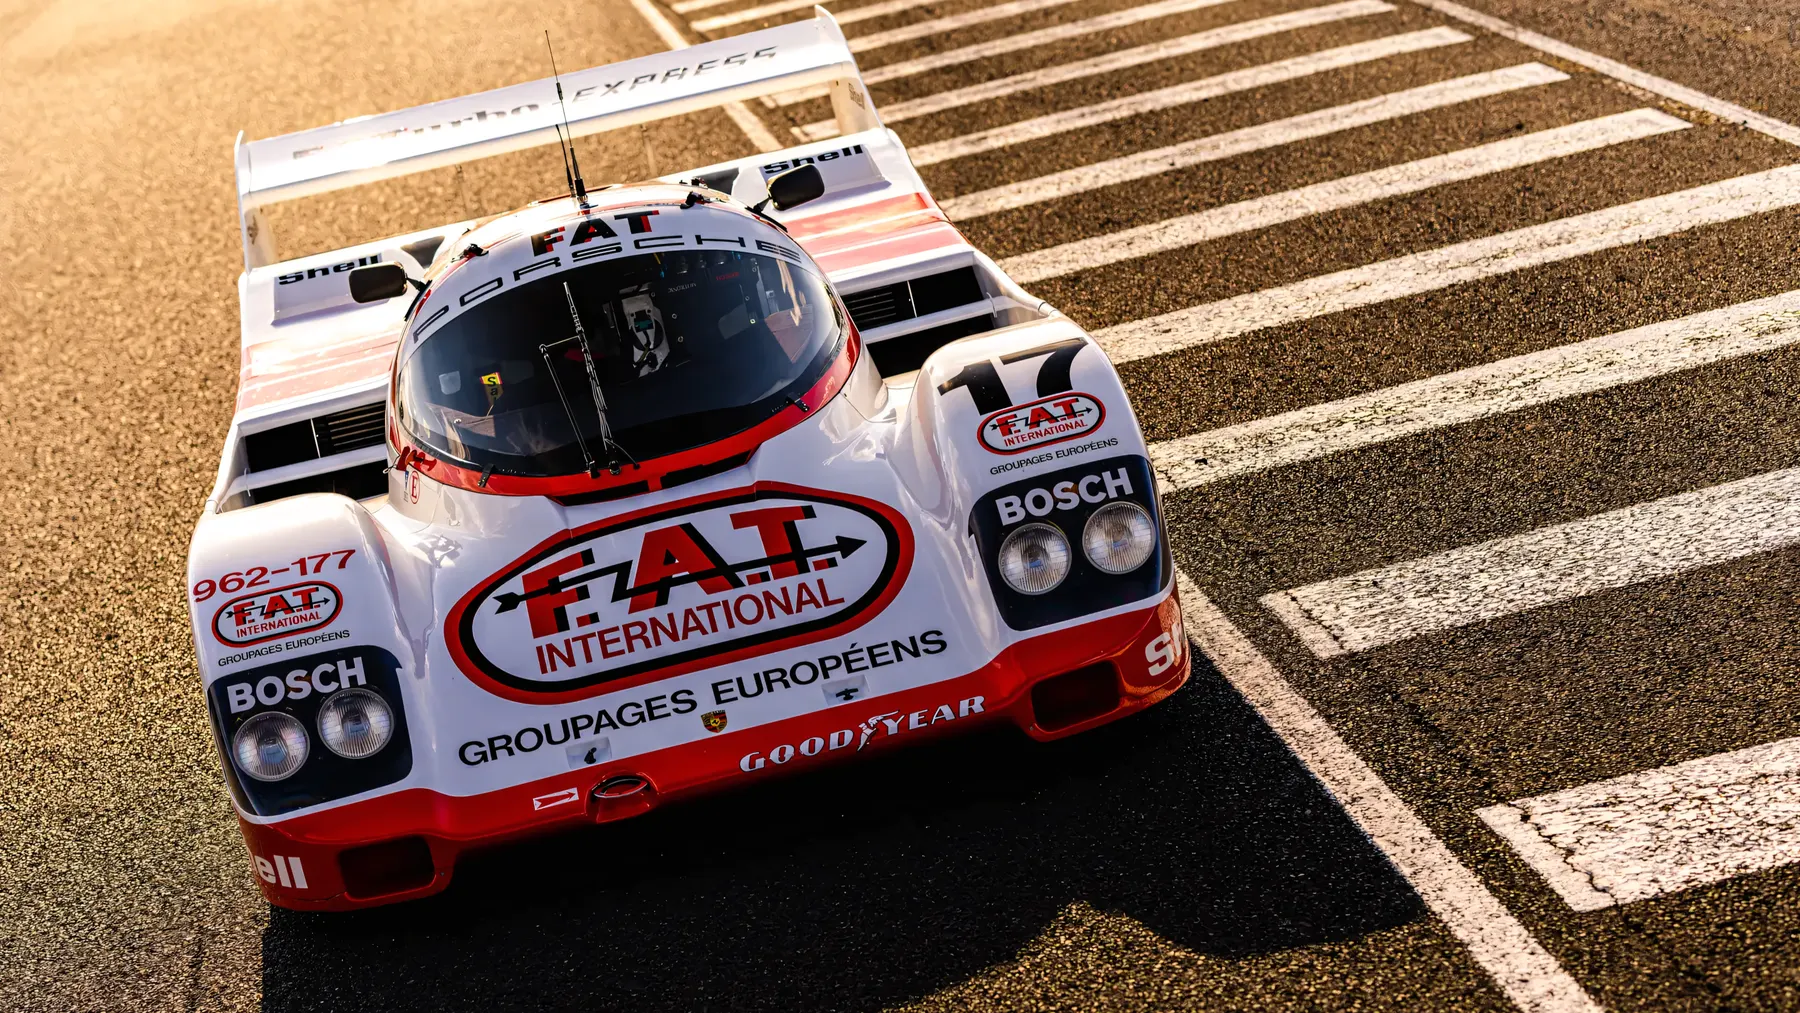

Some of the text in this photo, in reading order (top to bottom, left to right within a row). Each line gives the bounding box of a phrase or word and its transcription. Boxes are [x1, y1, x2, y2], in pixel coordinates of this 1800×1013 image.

[763, 144, 863, 174] Shell
[531, 209, 660, 257] FAT
[278, 254, 380, 286] Shell
[412, 234, 802, 344] PORSCHE
[937, 336, 1089, 417] 17
[989, 437, 1119, 476] GROUPAGES EUROPÉENS
[1003, 419, 1088, 447] INTERNATIONAL
[994, 466, 1134, 526] BOSCH
[192, 549, 357, 603] 962-177
[521, 504, 839, 639] F.A.T.
[217, 629, 350, 667] GROUPAGES EUROPÉENS
[236, 611, 322, 639] INTERNATIONAL
[535, 578, 845, 675] INTERNATIONAL
[225, 656, 368, 715] BOSCH
[457, 629, 948, 767] GROUPAGES EUROPÉENS
